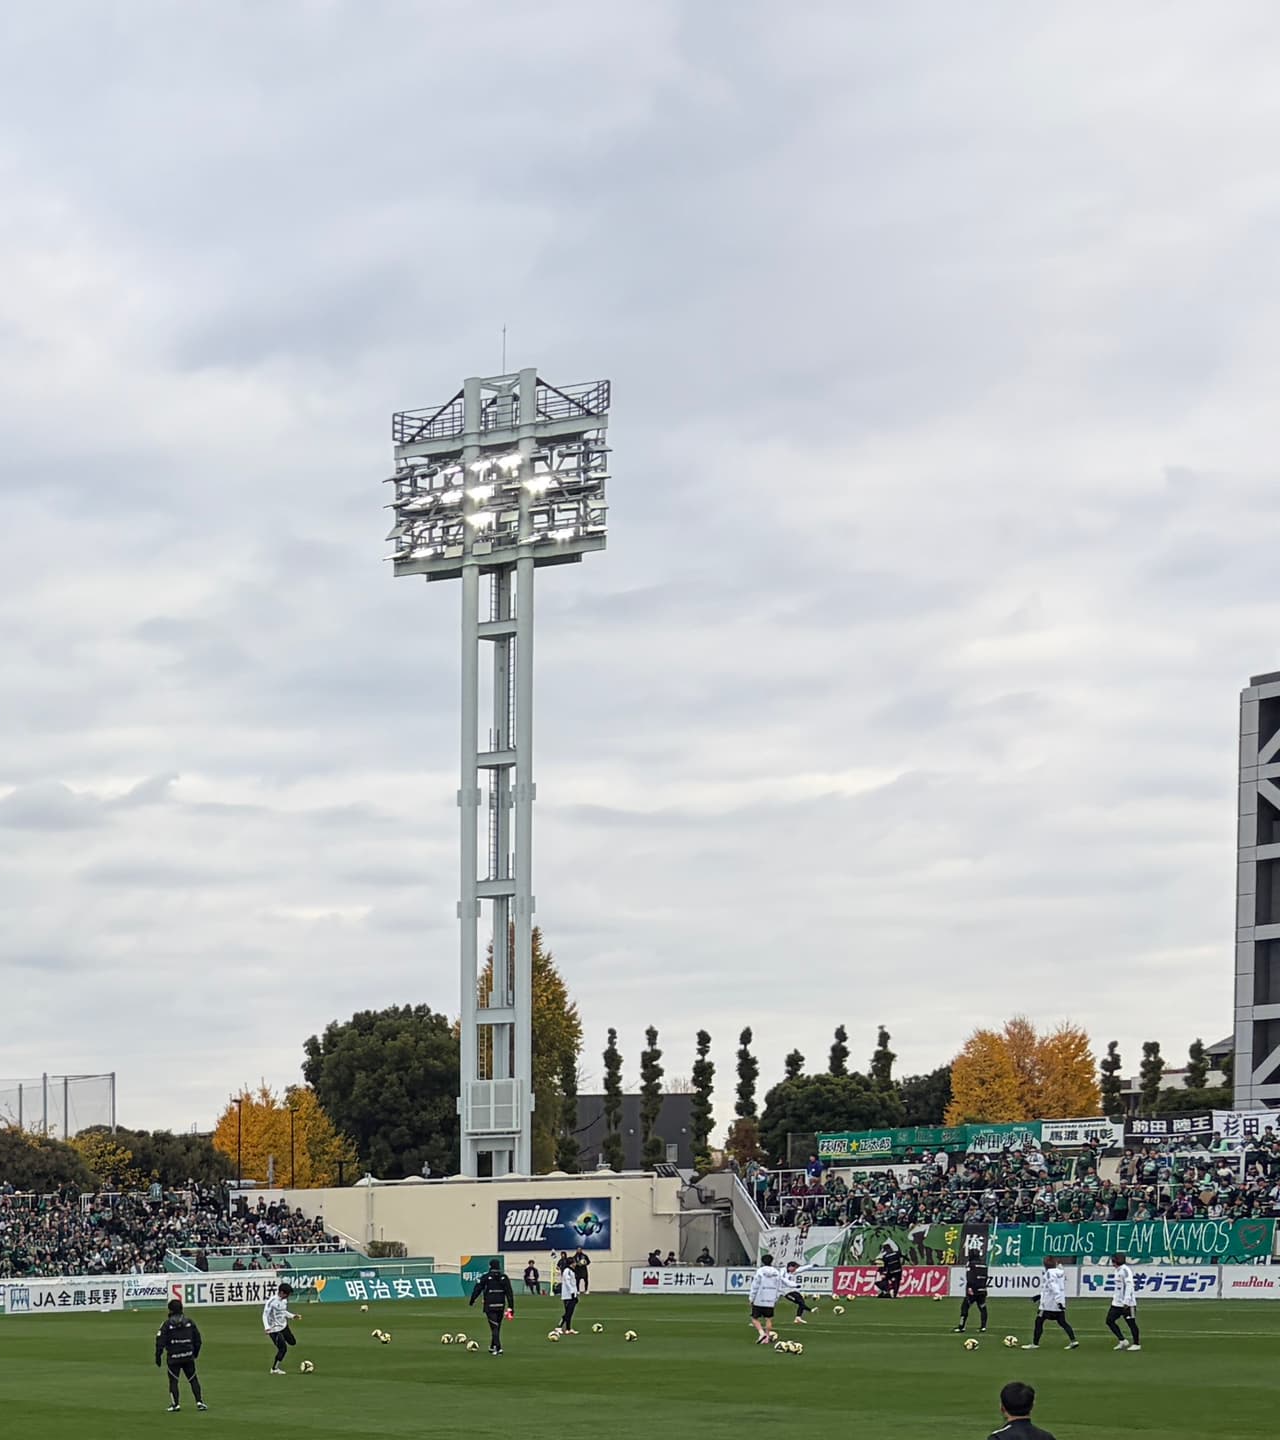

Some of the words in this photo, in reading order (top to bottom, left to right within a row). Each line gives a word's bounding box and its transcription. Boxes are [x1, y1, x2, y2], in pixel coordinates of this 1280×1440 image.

[504, 1204, 559, 1226] amino
[503, 1224, 545, 1242] VITAL
[1027, 1224, 1094, 1253] Thanks
[1102, 1222, 1156, 1253] TEAM
[1163, 1221, 1233, 1253] VAMOS
[345, 1278, 438, 1300] 明治安田
[663, 1272, 714, 1286] 三井ホーム
